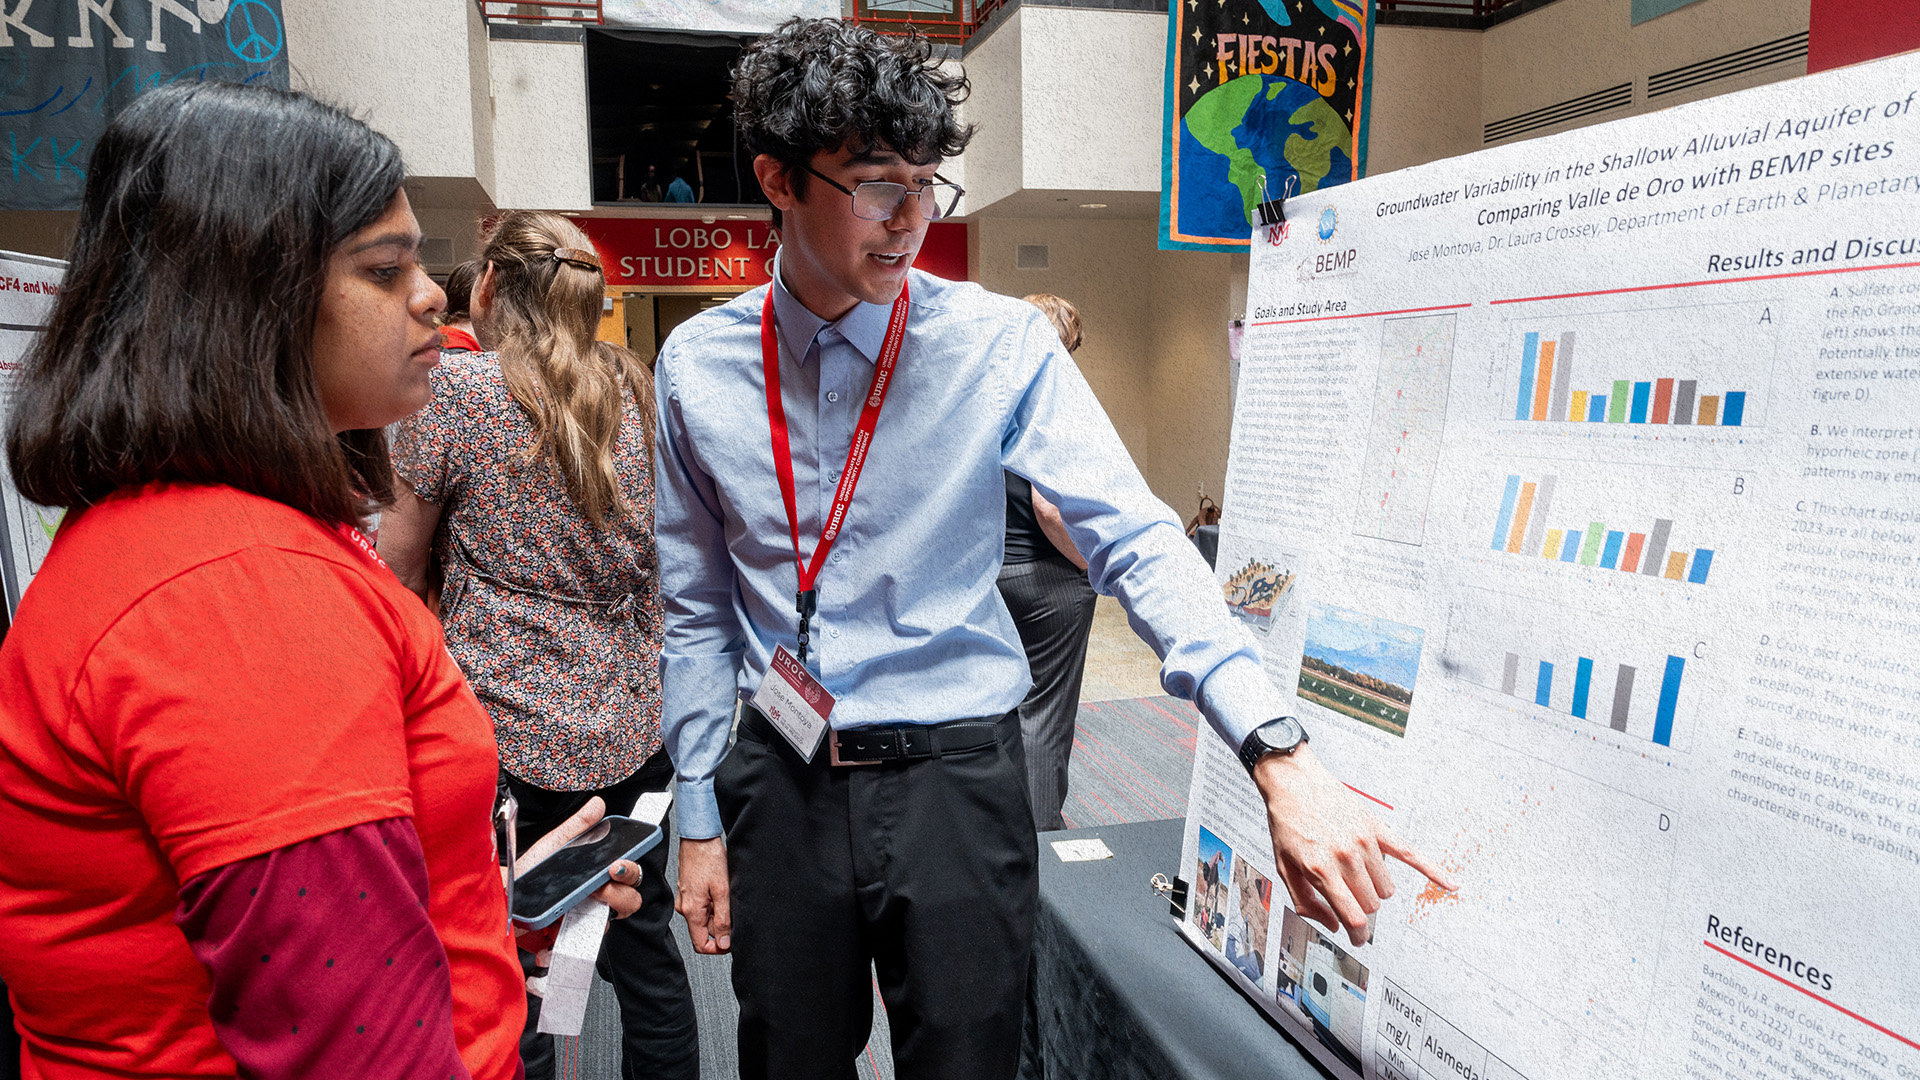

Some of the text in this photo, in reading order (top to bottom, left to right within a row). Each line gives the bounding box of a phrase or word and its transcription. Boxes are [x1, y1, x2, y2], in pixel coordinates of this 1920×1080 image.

[1216, 33, 1337, 97] FIESTAS
[1376, 91, 1917, 218] Groundwater Variability in the Shallow Alluvial Aquifer of
[1477, 141, 1895, 226] Comparing Valle de Oro with BEMP sites
[1408, 175, 1920, 263] Jose Montoya, Dr. Laura Crossey, Department of Earth & Planetary
[655, 227, 732, 249] LOBO
[620, 256, 751, 279] STUDENT
[1315, 249, 1357, 273] BEMP
[1708, 248, 1784, 274] Results
[1791, 240, 1838, 265] and
[23, 281, 41, 294] and
[1848, 282, 1895, 297] Sulfate
[1254, 300, 1347, 320] Goals and Study Area
[1758, 307, 1772, 325] A
[1826, 305, 1873, 319] the Rio
[882, 297, 904, 368] UNDERGRADUATE RESEARCH
[887, 300, 908, 369] OPPORTUNITY CONFERENCE
[1853, 325, 1896, 338] shows
[1819, 345, 1891, 361] Potentially
[876, 370, 888, 398] UROC
[1816, 369, 1878, 380] extensive
[1812, 388, 1851, 402] figure
[1827, 425, 1848, 437] We
[1852, 427, 1914, 440] interpret
[838, 429, 865, 502] UNDERGRADUATE RESEARCH
[1806, 444, 1909, 460] hyporheic zone
[843, 432, 870, 502] OPPORTUNITY CONFERENCE
[1803, 466, 1890, 484] patterns may
[1733, 477, 1745, 495] B
[829, 502, 845, 533] UROC
[1813, 501, 1837, 515] This
[1841, 505, 1876, 519] chart
[1791, 520, 1823, 534] 2023
[1826, 526, 1847, 538] are
[1871, 529, 1915, 544] below
[351, 530, 386, 569] UROC
[1786, 542, 1913, 566] unusual compared
[1693, 641, 1707, 659] C
[777, 650, 805, 682] UROC
[1755, 652, 1870, 690] BEMP legacy sites
[770, 685, 786, 702] Jose
[785, 699, 812, 730] Montoya
[1823, 690, 1848, 707] The
[1852, 696, 1892, 717] linear
[1745, 694, 1908, 746] sourced ground water as
[1752, 731, 1784, 751] Table
[1786, 741, 1842, 770] showing
[1845, 759, 1891, 783] ranges
[1733, 749, 1903, 811] and selected BEMP legacy
[1727, 787, 1800, 821] characterize
[1803, 813, 1847, 838] nitrate
[1730, 768, 1796, 798] mentioned
[1800, 791, 1811, 803] in
[1815, 794, 1824, 807] C
[1877, 814, 1902, 833] the
[1659, 813, 1671, 832] D
[1706, 914, 1834, 992] References
[1702, 964, 1750, 999] Bartolino,
[1774, 1002, 1795, 1019] and
[1384, 987, 1422, 1028] Nitrate
[1700, 980, 1815, 1050] Mexico US
[1385, 1021, 1479, 1080] mg/L Alameda
[1388, 1048, 1405, 1071] Min
[1688, 1048, 1723, 1075] stream
[1765, 1055, 1788, 1074] And
